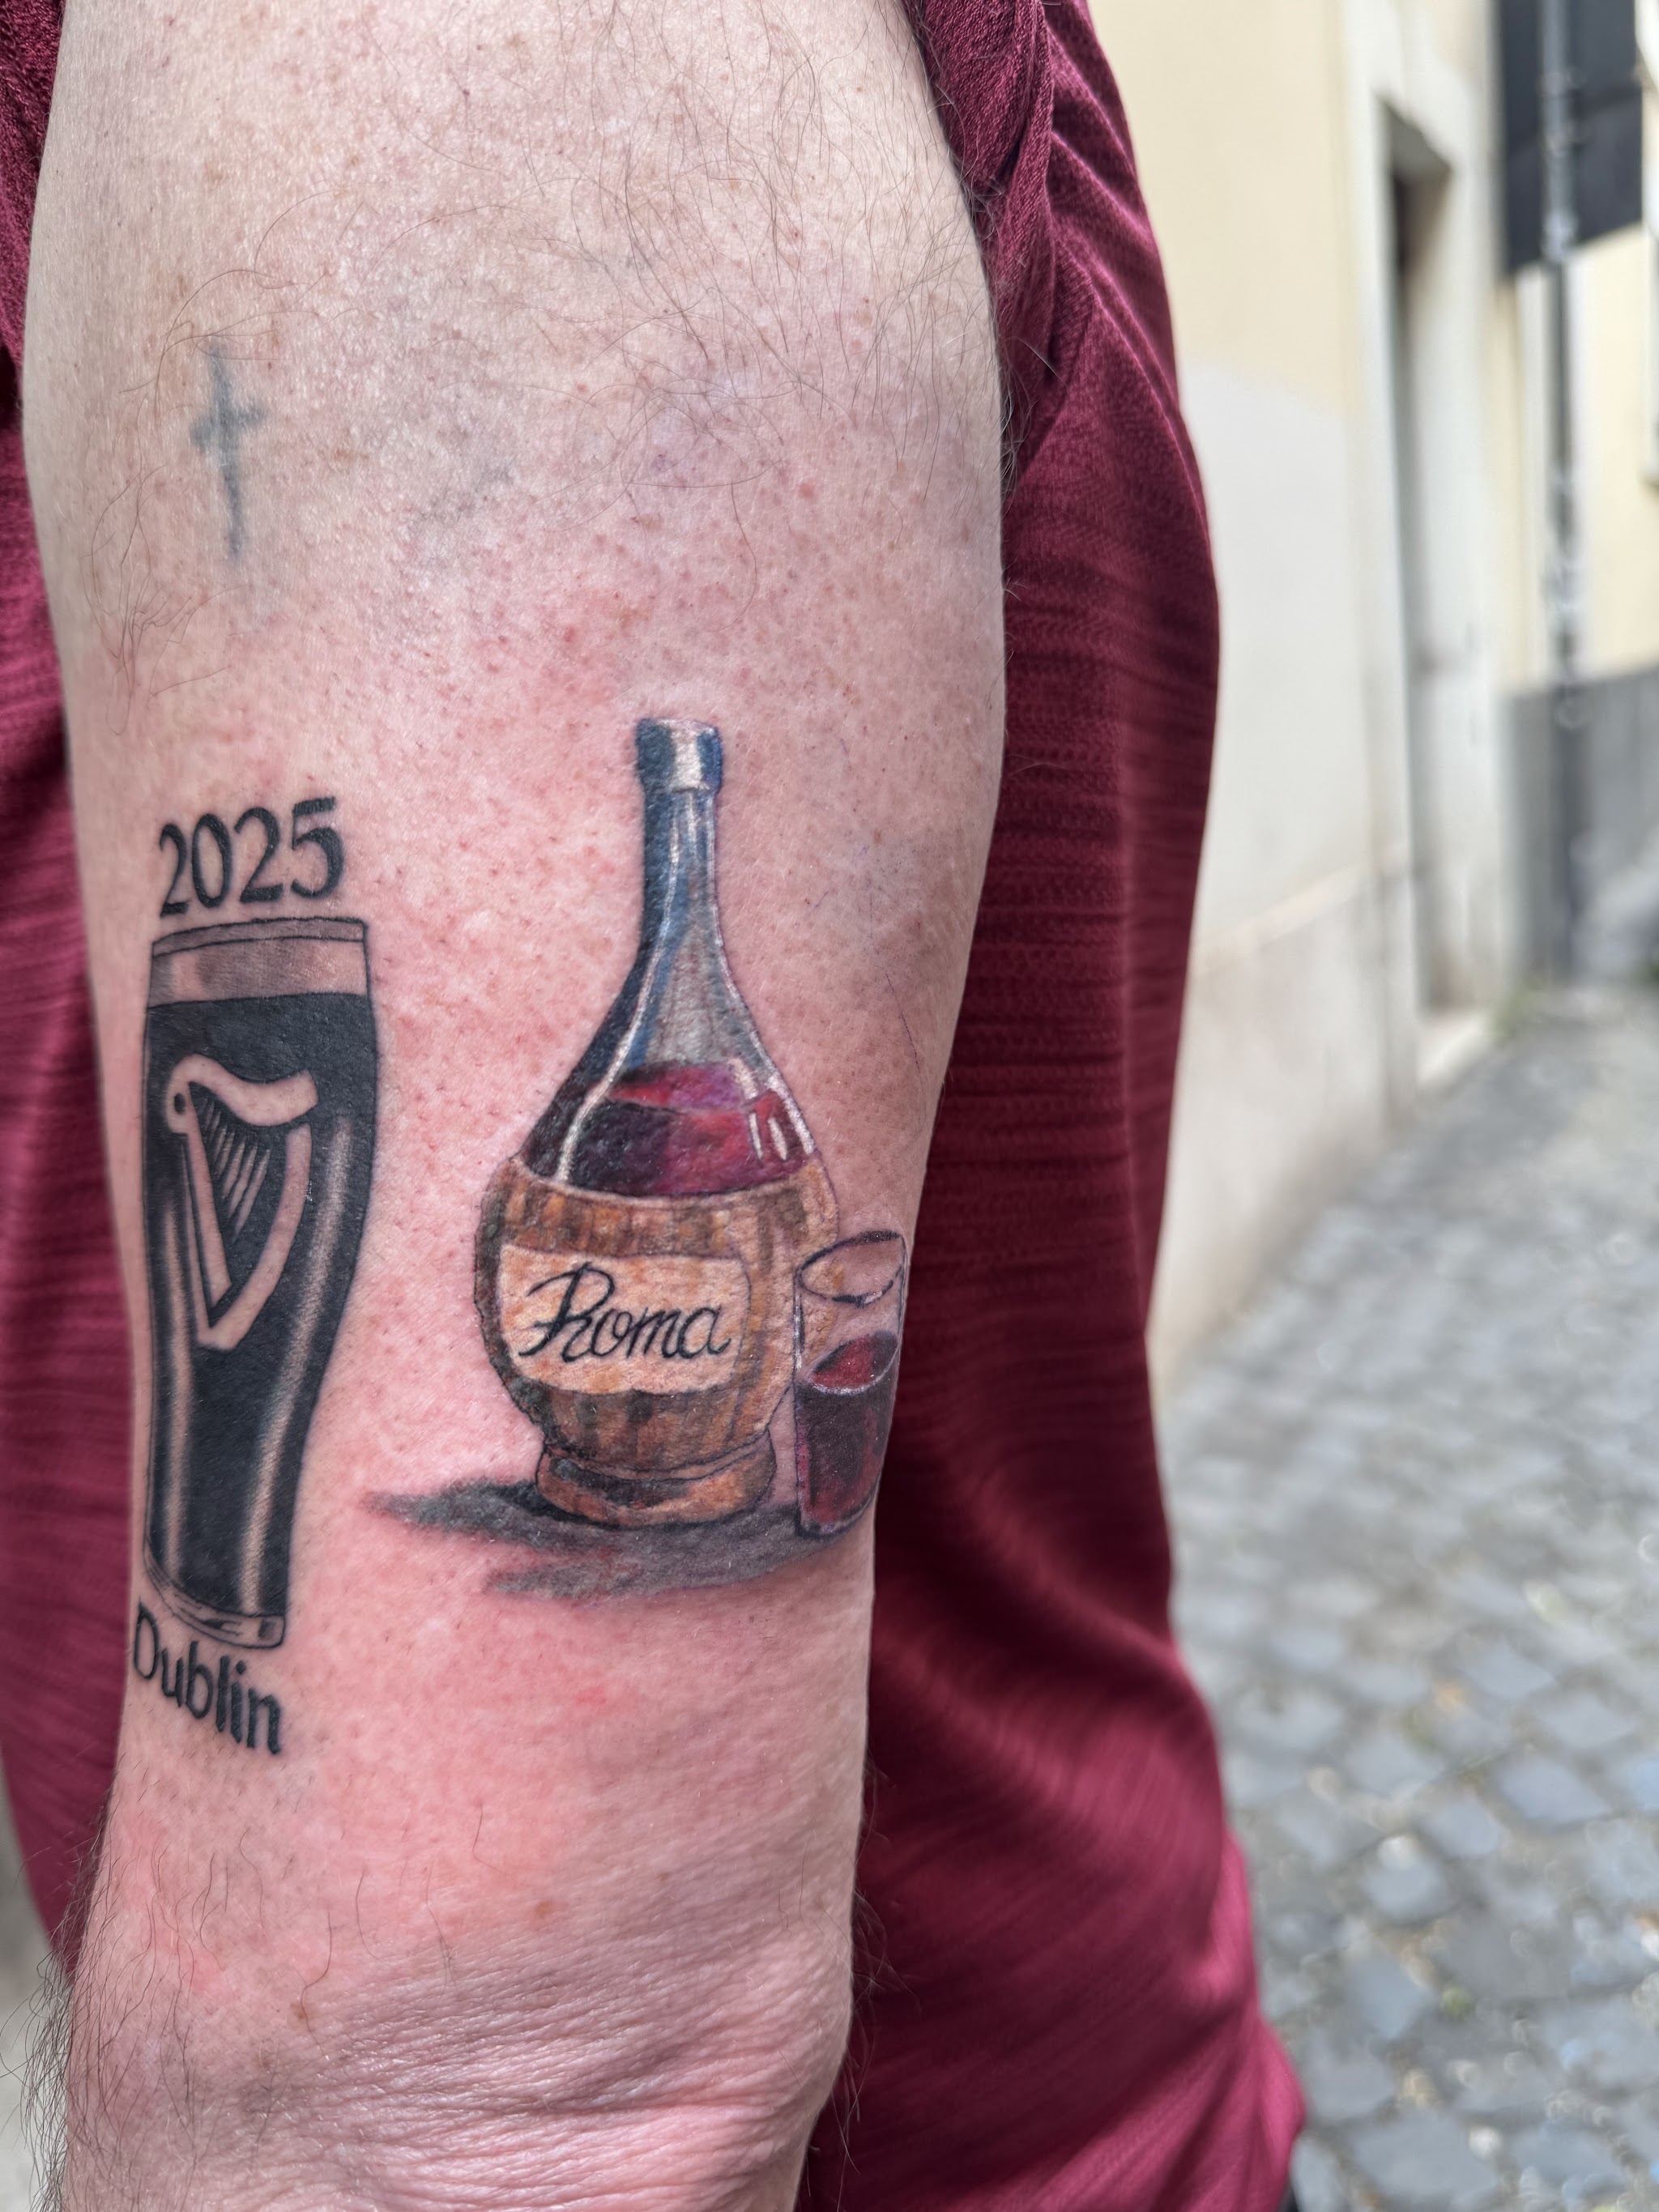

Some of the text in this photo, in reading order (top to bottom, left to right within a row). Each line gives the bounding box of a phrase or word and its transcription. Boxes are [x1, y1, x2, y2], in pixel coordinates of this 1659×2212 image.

[158, 795, 345, 918] 2025
[518, 1260, 732, 1363] Roma
[133, 1597, 282, 1755] Dublin
